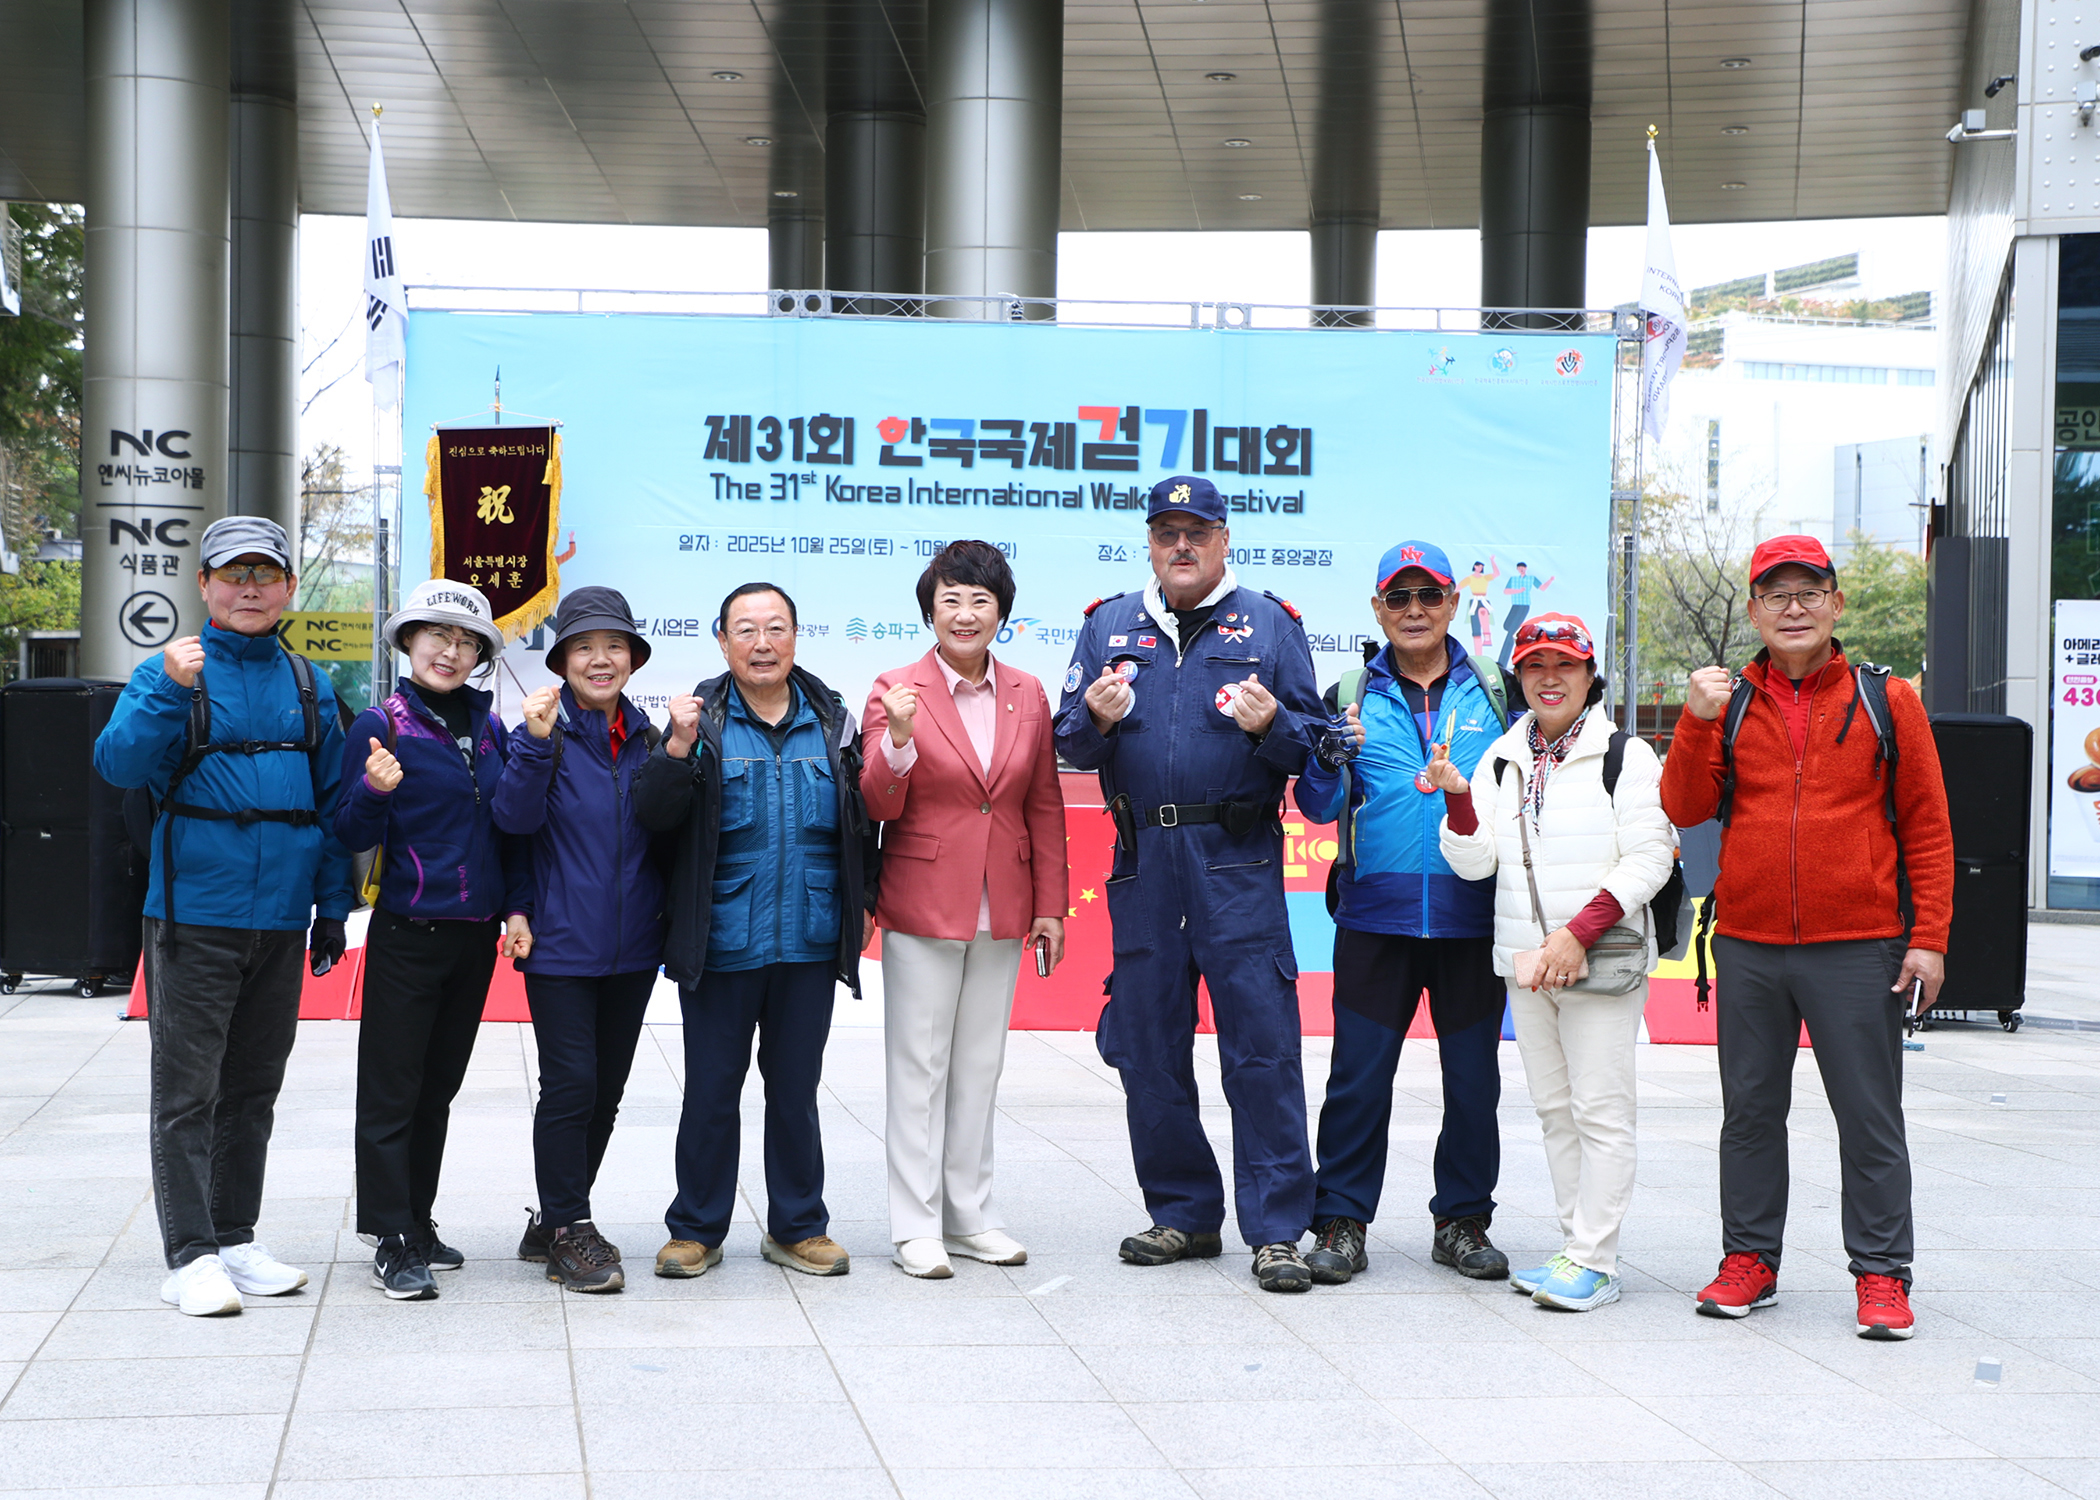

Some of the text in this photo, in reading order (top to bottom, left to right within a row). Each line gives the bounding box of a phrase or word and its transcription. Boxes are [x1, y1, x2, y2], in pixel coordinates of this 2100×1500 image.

[111, 430, 192, 459] NC
[449, 444, 546, 457] 진심으로 축하드립니다
[703, 406, 1312, 475] 제31회 한국국제걷기대회
[98, 464, 206, 490] 엔씨뉴코아몰
[710, 470, 1303, 513] The 31st Korea International Walki estival
[477, 485, 515, 525] 祝
[110, 518, 191, 547] NC
[728, 535, 785, 553] 2025년
[791, 536, 824, 554] 10월
[829, 538, 894, 556] 25일(토)
[1400, 545, 1426, 564] NY
[119, 554, 181, 577] 식품관
[463, 555, 528, 568] 서울특별시장
[1272, 548, 1334, 566] 중앙광장
[427, 592, 480, 615] LIFEWORK
[306, 620, 339, 632] NC
[651, 618, 699, 637] 사업은
[871, 622, 920, 640] 송파구
[306, 639, 342, 652] NC
